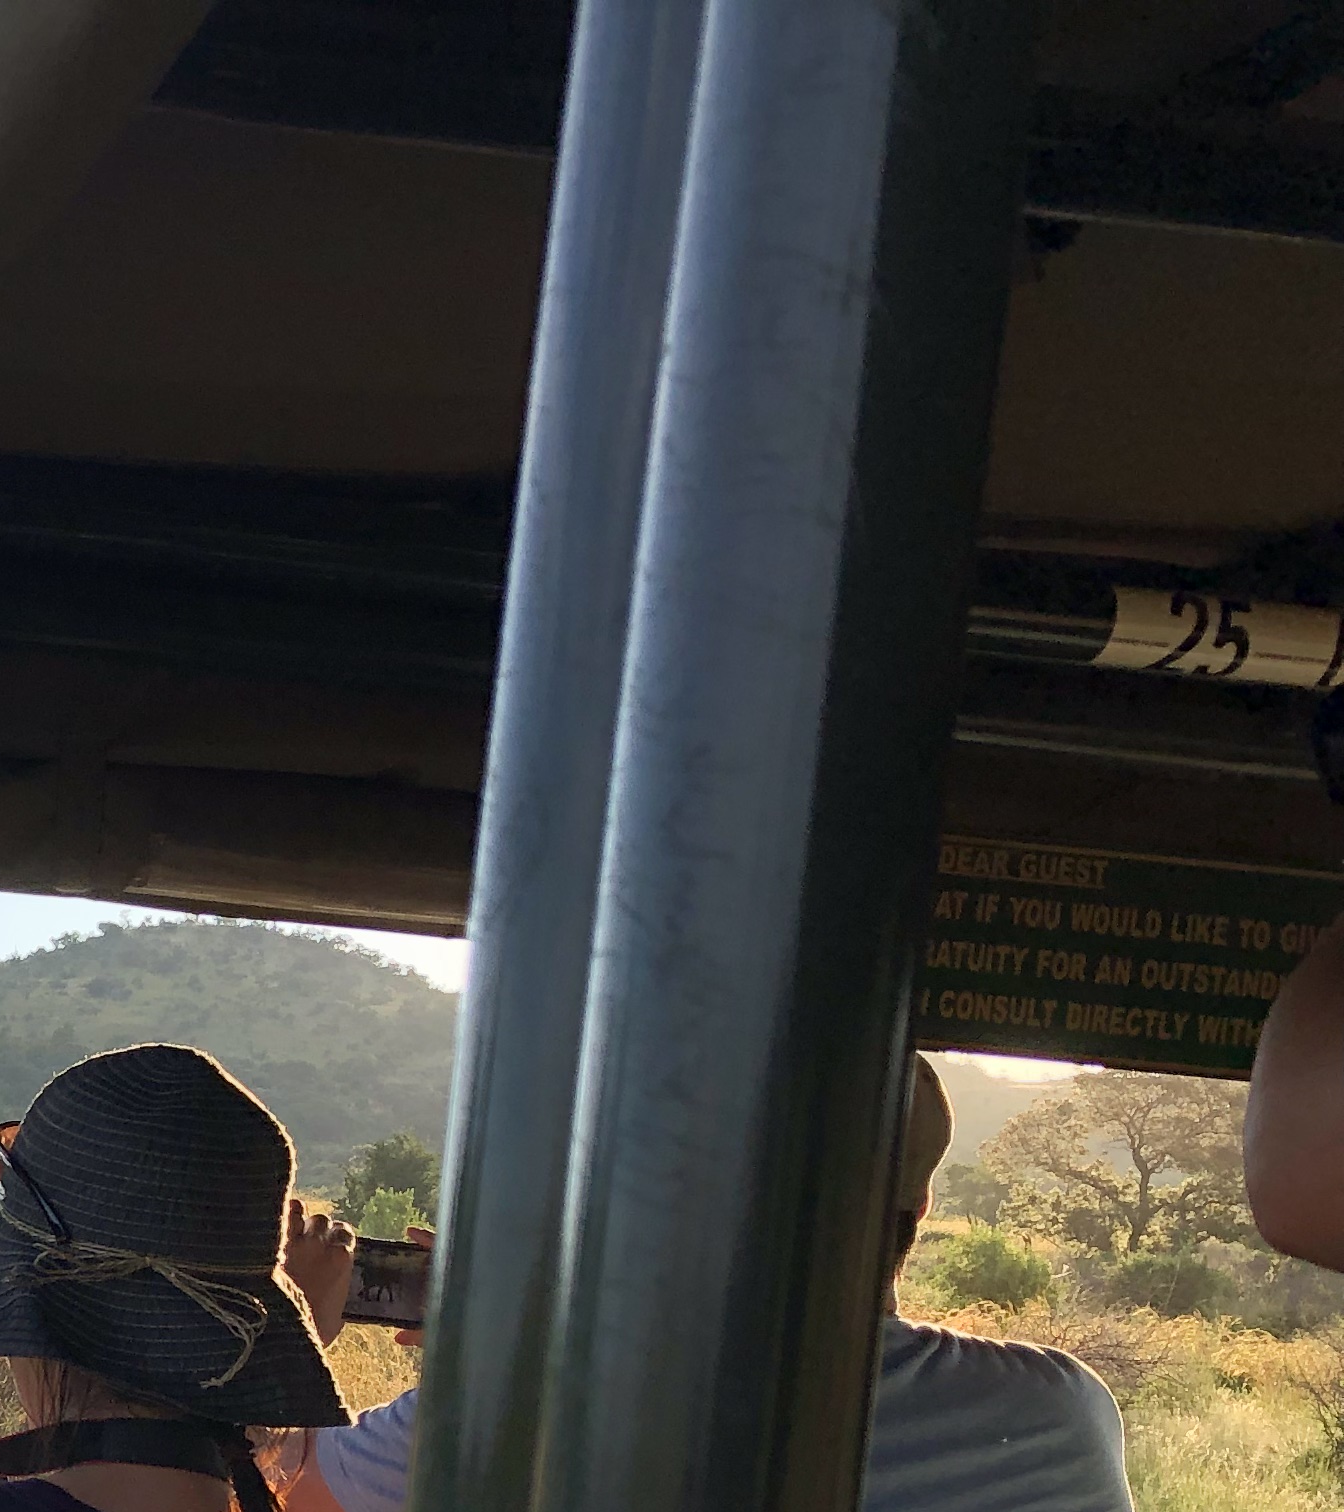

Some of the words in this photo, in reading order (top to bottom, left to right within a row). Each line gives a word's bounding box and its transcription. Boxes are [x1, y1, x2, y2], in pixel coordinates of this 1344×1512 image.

[1142, 592, 1251, 677] 25
[938, 845, 1010, 880] DEAR
[1018, 851, 1108, 888] GUEST
[976, 893, 999, 924] IF
[1010, 897, 1062, 930] YOU
[1071, 903, 1161, 938] WOULD
[1171, 911, 1229, 946] LIKE
[1239, 918, 1271, 949] TO
[1036, 949, 1086, 981] FOR
[1095, 955, 1132, 987] AN
[939, 989, 1057, 1029] CONSULT
[1066, 1001, 1189, 1041] DIRECTLY
